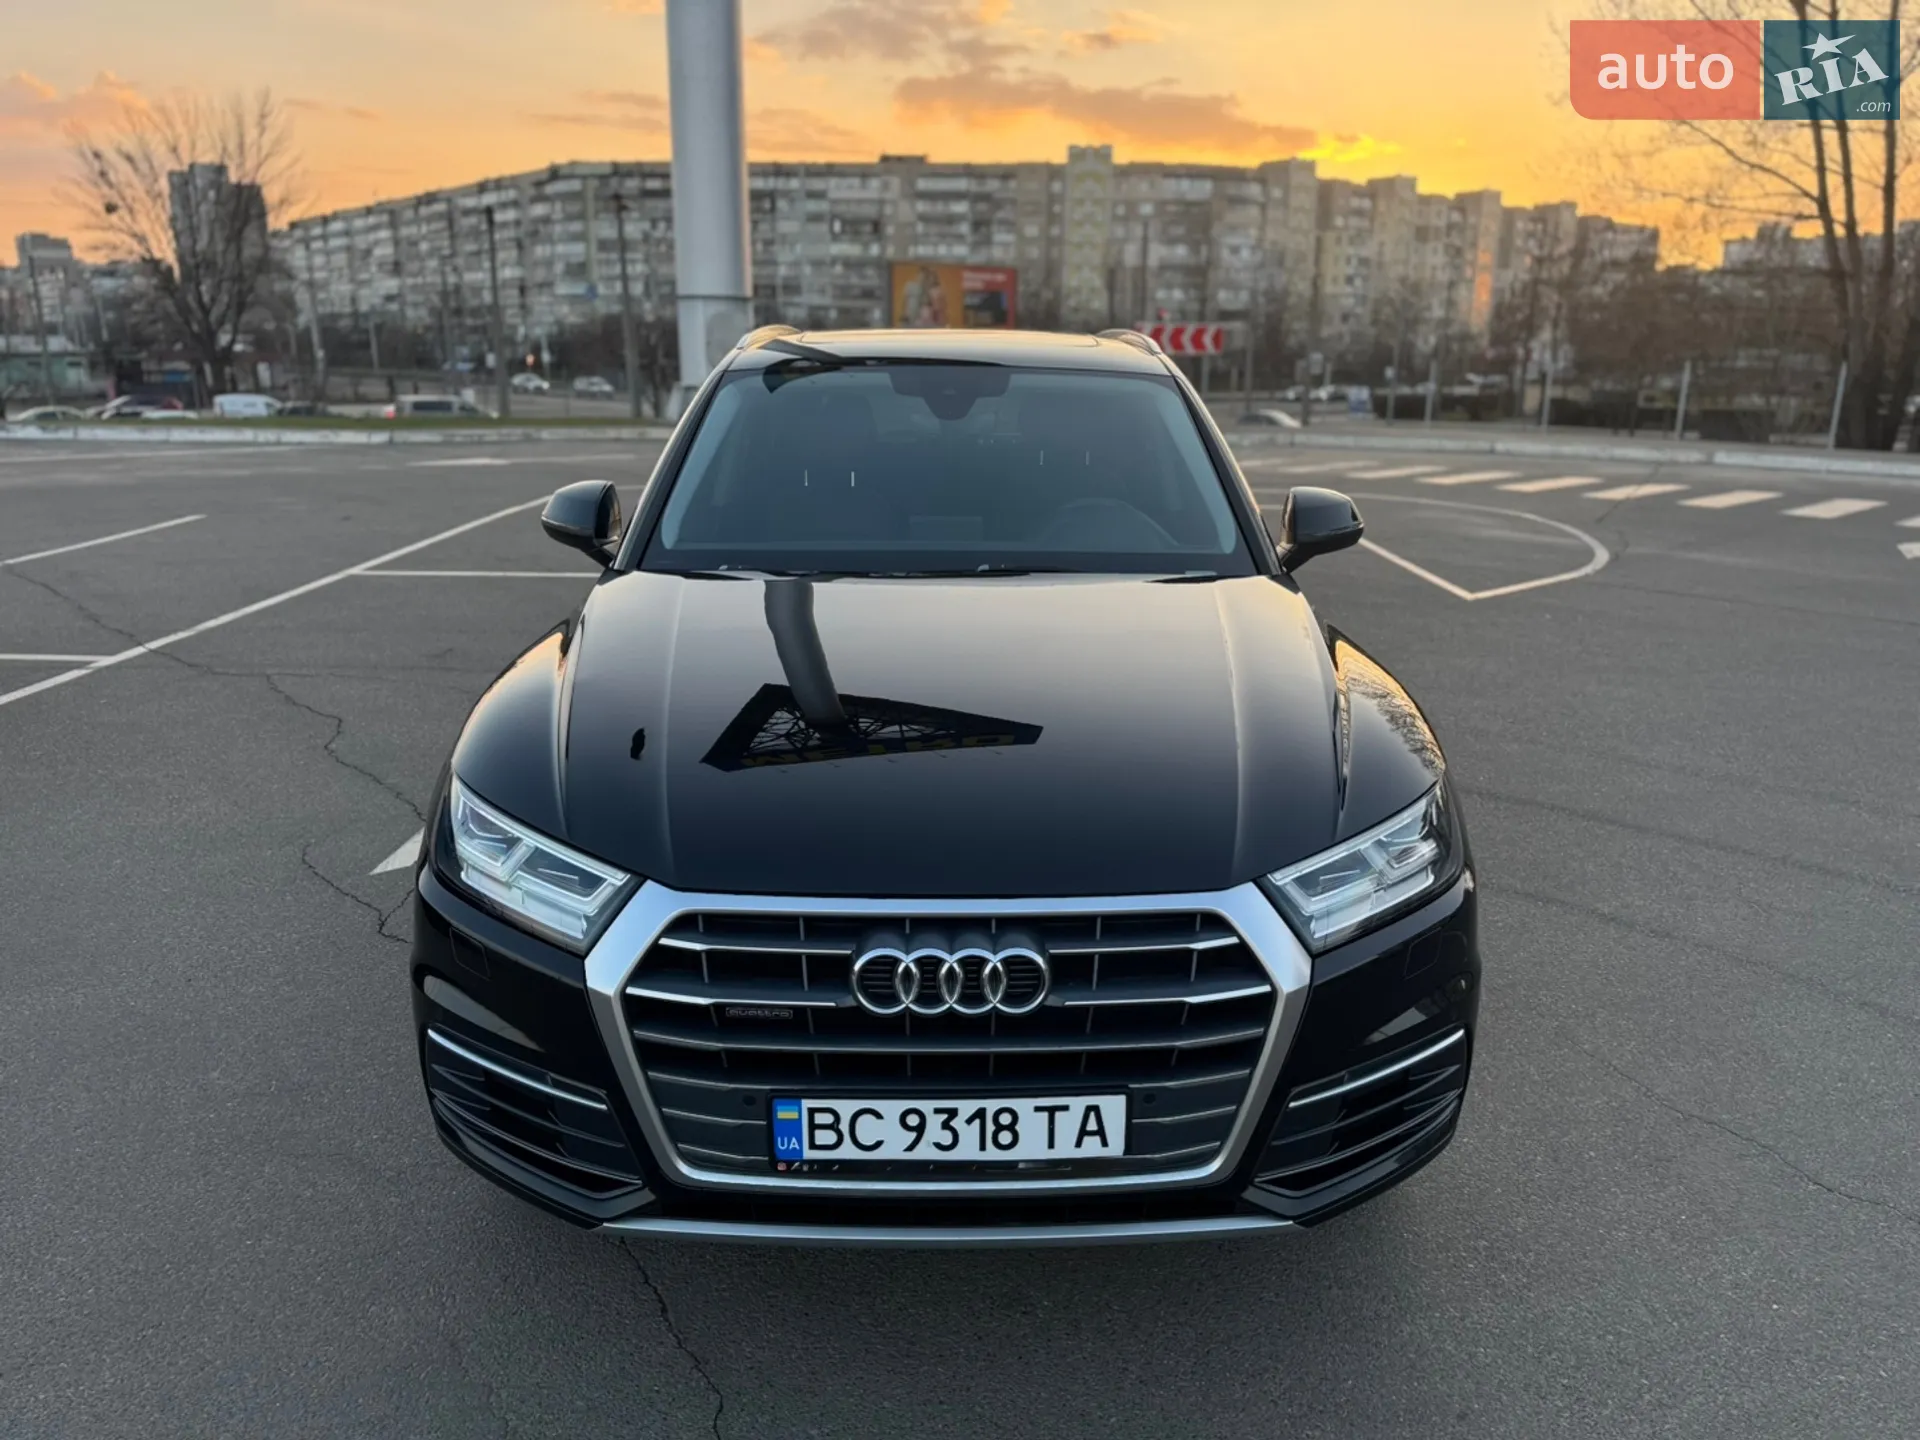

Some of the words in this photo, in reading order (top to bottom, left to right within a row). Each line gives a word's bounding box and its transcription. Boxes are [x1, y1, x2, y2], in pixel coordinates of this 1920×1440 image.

[777, 1136, 800, 1150] UA
[806, 1106, 885, 1151] BC
[899, 1106, 1020, 1152] 9318
[1033, 1104, 1109, 1149] TA
